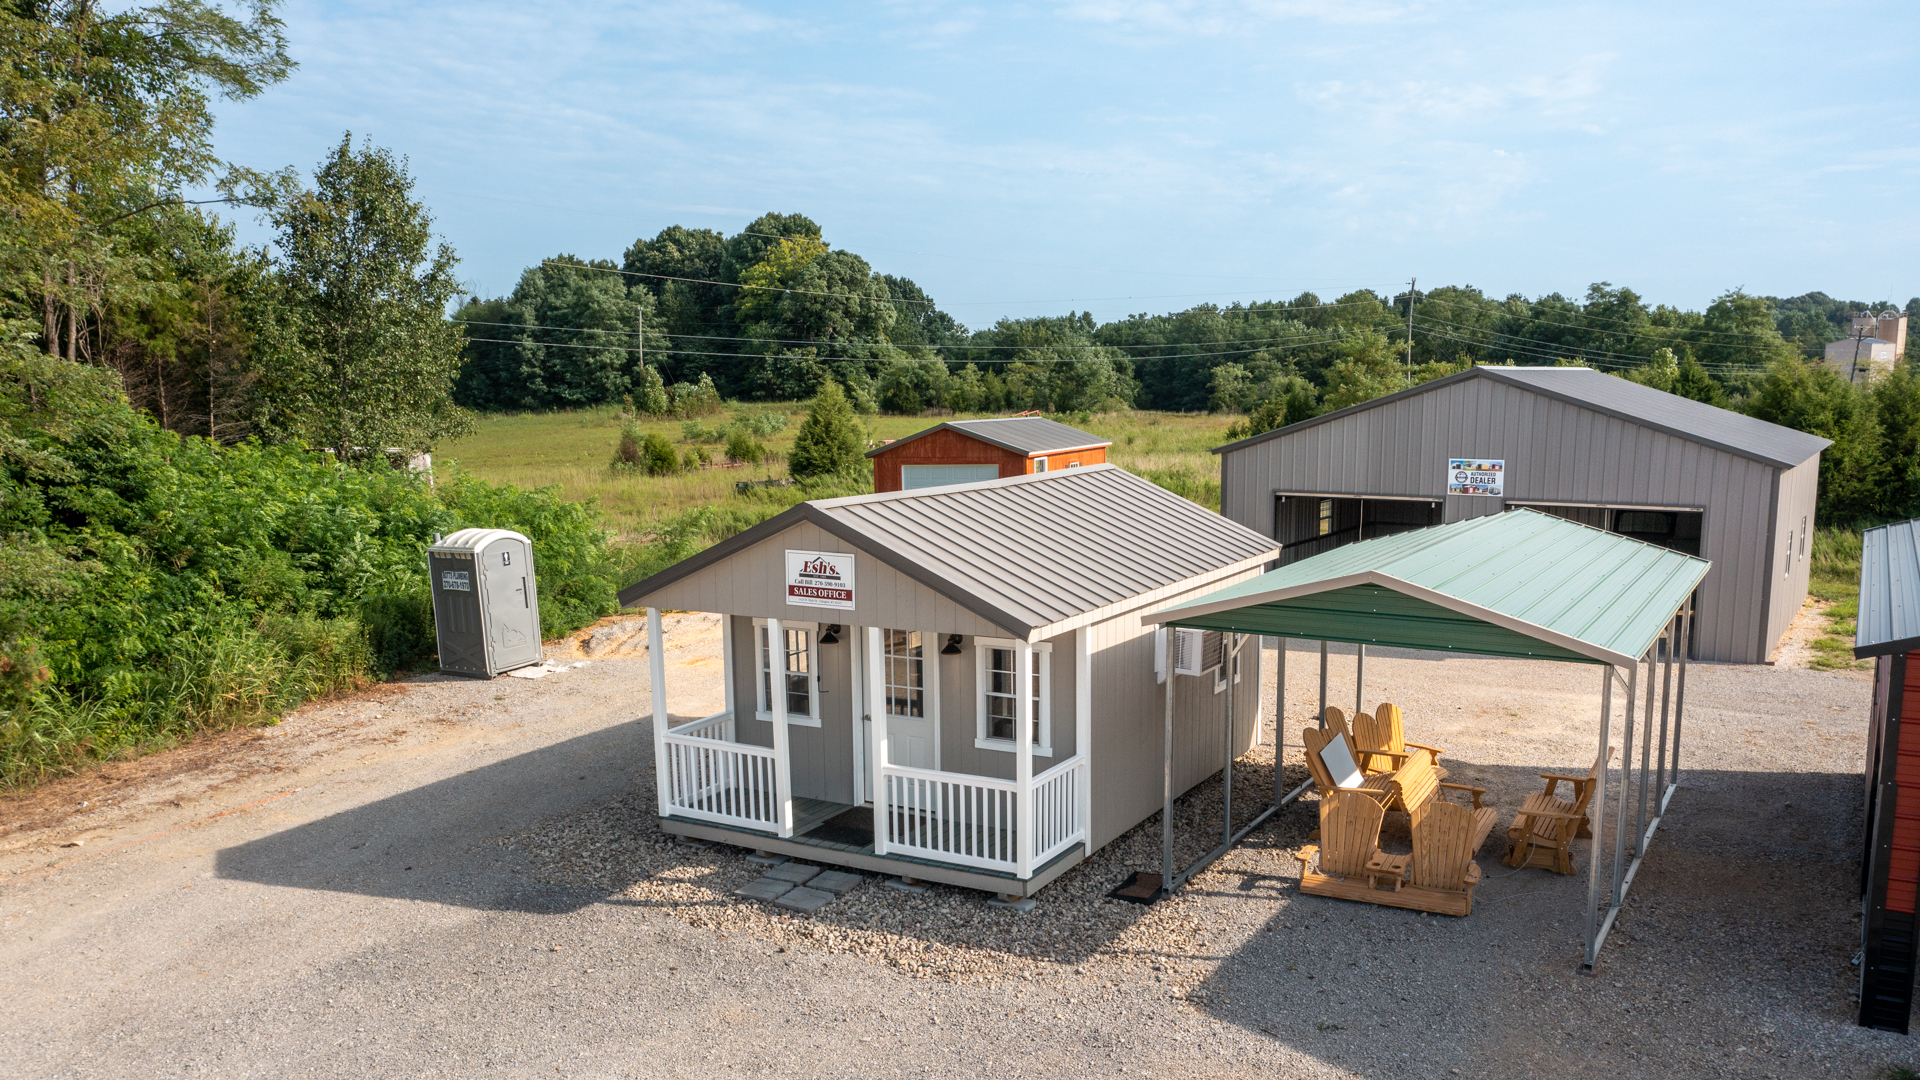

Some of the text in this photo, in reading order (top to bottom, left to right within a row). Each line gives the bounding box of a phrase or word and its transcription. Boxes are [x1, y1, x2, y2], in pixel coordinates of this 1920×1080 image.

[803, 561, 836, 575] Esh's
[453, 572, 468, 580] PLUMBING
[794, 587, 847, 599] SALES OFFICE
